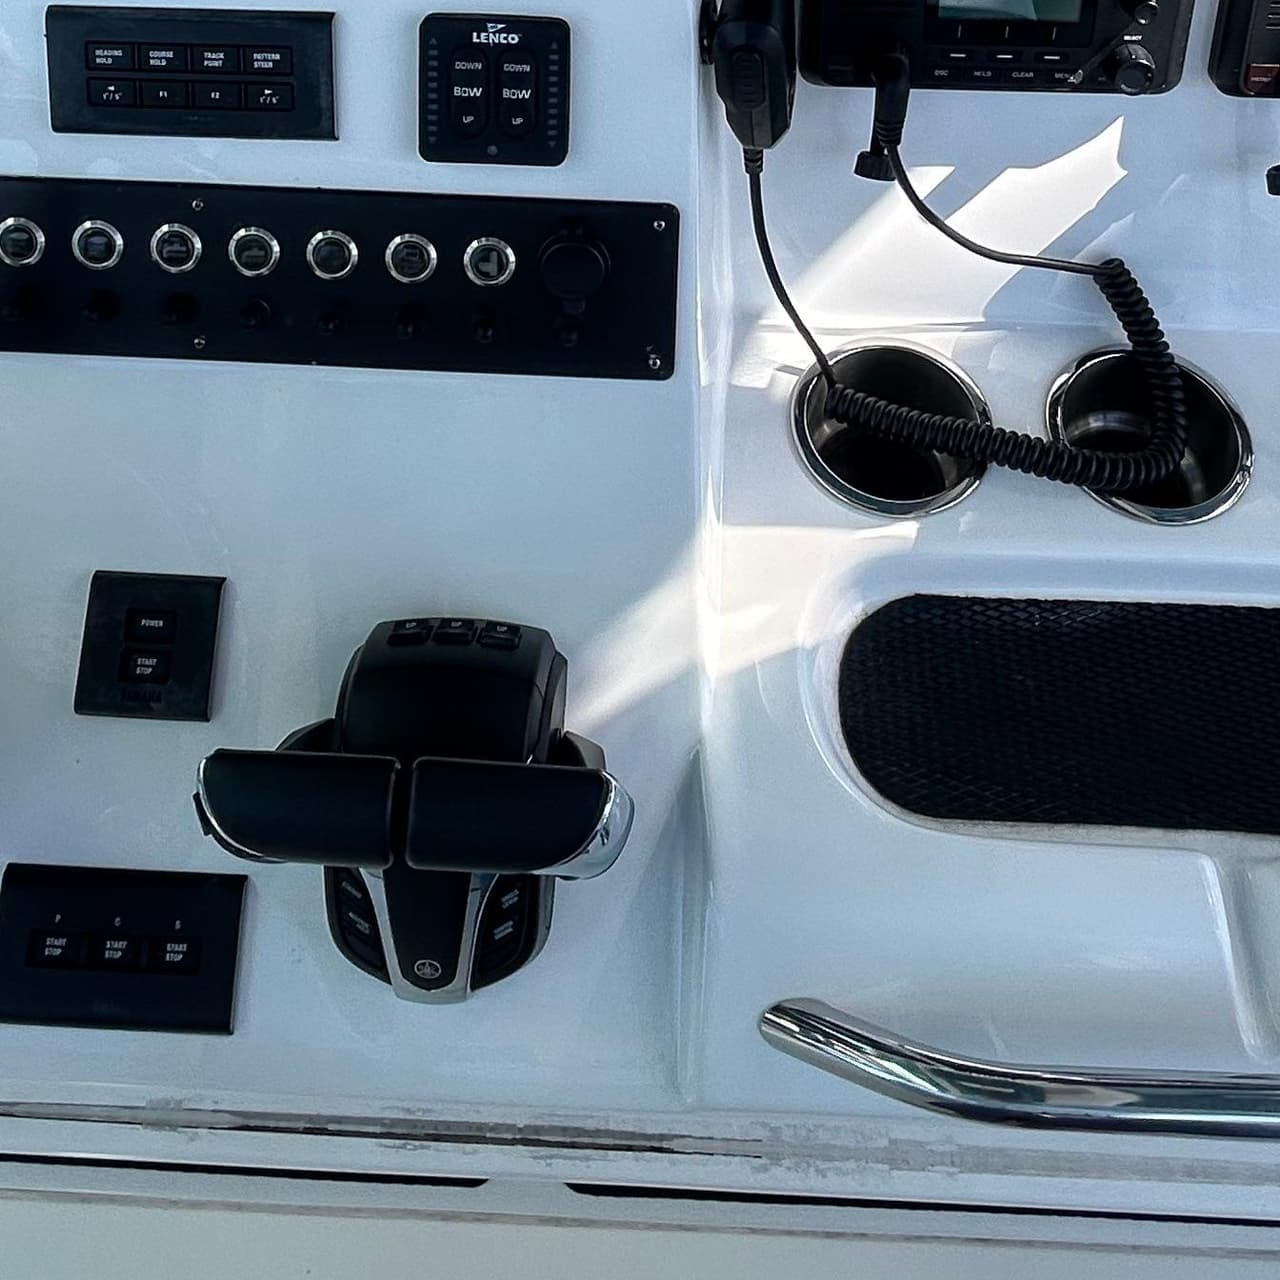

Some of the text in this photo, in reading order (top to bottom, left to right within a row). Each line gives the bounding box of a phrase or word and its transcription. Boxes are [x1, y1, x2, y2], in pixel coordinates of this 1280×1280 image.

[472, 32, 520, 45] LENCO
[454, 61, 482, 71] DOWN
[503, 63, 531, 73] DOWN
[453, 86, 483, 97] BOW
[502, 88, 532, 99] BOW
[462, 115, 475, 124] UP
[511, 117, 524, 126] UP
[141, 619, 163, 627] POWER
[137, 658, 157, 666] START
[136, 666, 153, 674] STOP
[46, 937, 67, 946] START
[106, 940, 128, 949] START
[44, 947, 63, 956] STOP
[166, 943, 188, 952] START
[105, 950, 123, 959] STOP
[165, 953, 183, 962] STOP
